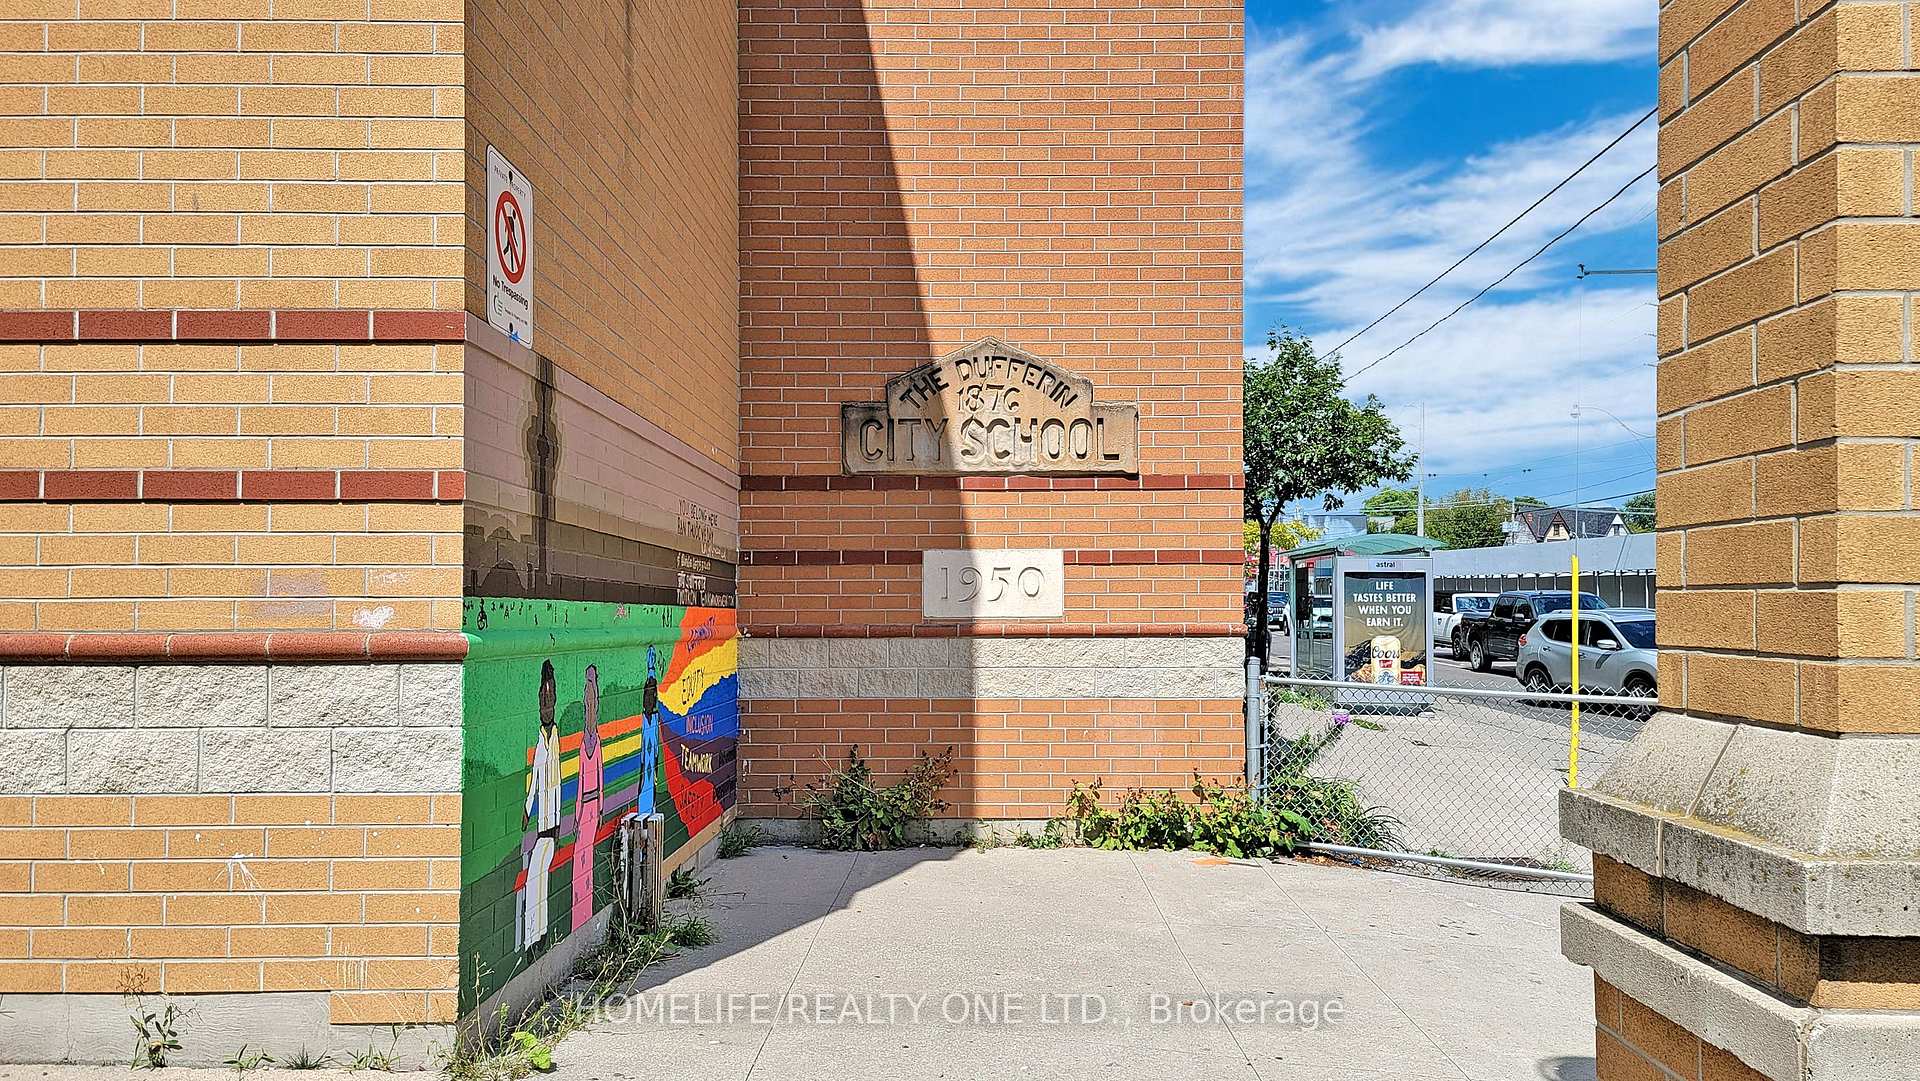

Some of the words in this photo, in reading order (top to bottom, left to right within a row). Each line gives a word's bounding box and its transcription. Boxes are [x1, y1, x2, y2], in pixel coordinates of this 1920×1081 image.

[492, 274, 500, 288] No
[501, 280, 528, 310] Trespassing
[899, 366, 950, 410] THE
[955, 355, 1079, 409] DUFFERIN
[956, 384, 1021, 413] 1876
[859, 417, 949, 462] CITY
[960, 417, 1120, 463] SCHOOL
[938, 566, 1046, 602] 1950
[1353, 593, 1382, 603] TASTES
[1386, 593, 1416, 603] BETTER
[1375, 581, 1394, 590] LIFE
[1358, 605, 1388, 614] WHEN
[1391, 605, 1412, 614] YOU
[1366, 618, 1390, 627] EARN
[1393, 618, 1404, 627] IT.
[1371, 645, 1400, 659] Coors
[681, 666, 705, 706] EQUITY
[685, 713, 714, 736] INCLUSION
[680, 743, 713, 774] TEAMWORK
